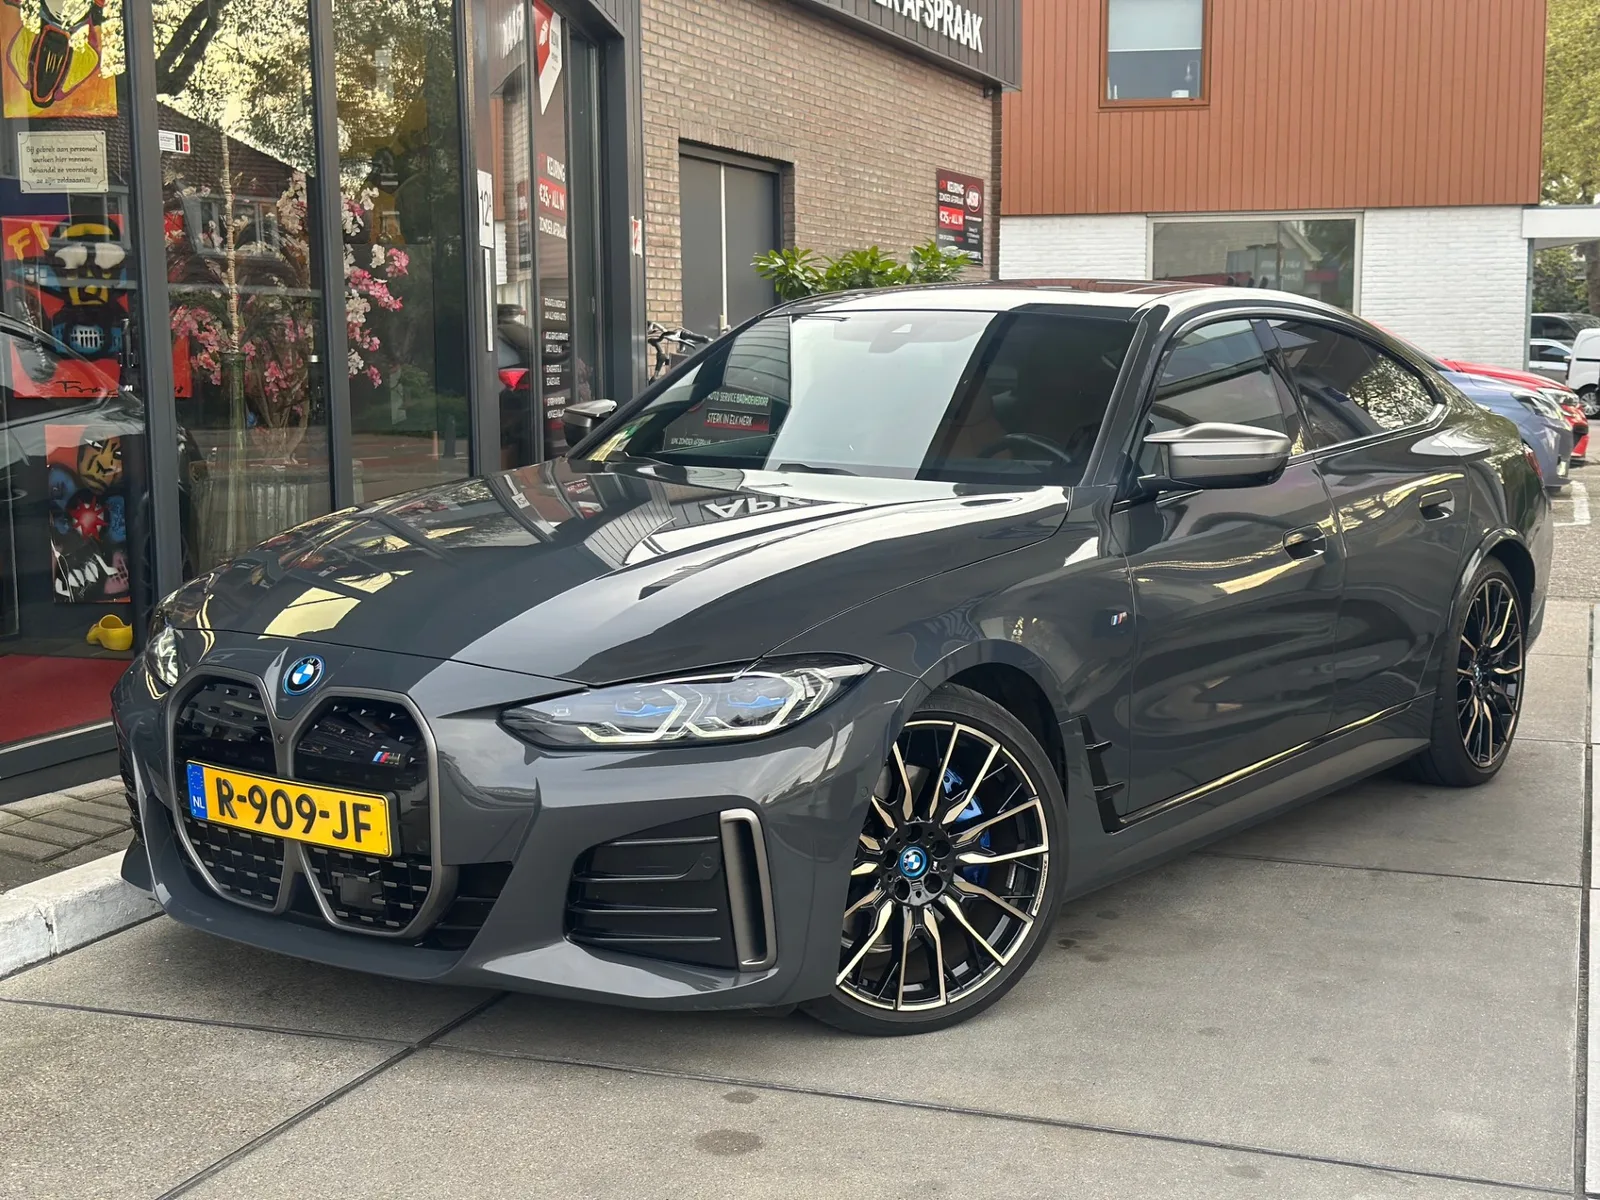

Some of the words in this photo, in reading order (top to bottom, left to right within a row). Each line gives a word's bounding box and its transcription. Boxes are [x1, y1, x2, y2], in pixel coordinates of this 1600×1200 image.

[901, 0, 983, 54] AFSPRAAK
[36, 146, 55, 154] gebrek
[69, 145, 98, 154] personeel
[65, 167, 98, 175] voorzichtig
[720, 391, 737, 404] SERVICE
[707, 412, 722, 424] STERK
[722, 413, 729, 424] IN
[729, 414, 739, 425] ELK
[739, 415, 753, 427] MERK
[192, 795, 206, 809] NL
[216, 777, 372, 843] R-909-JF
